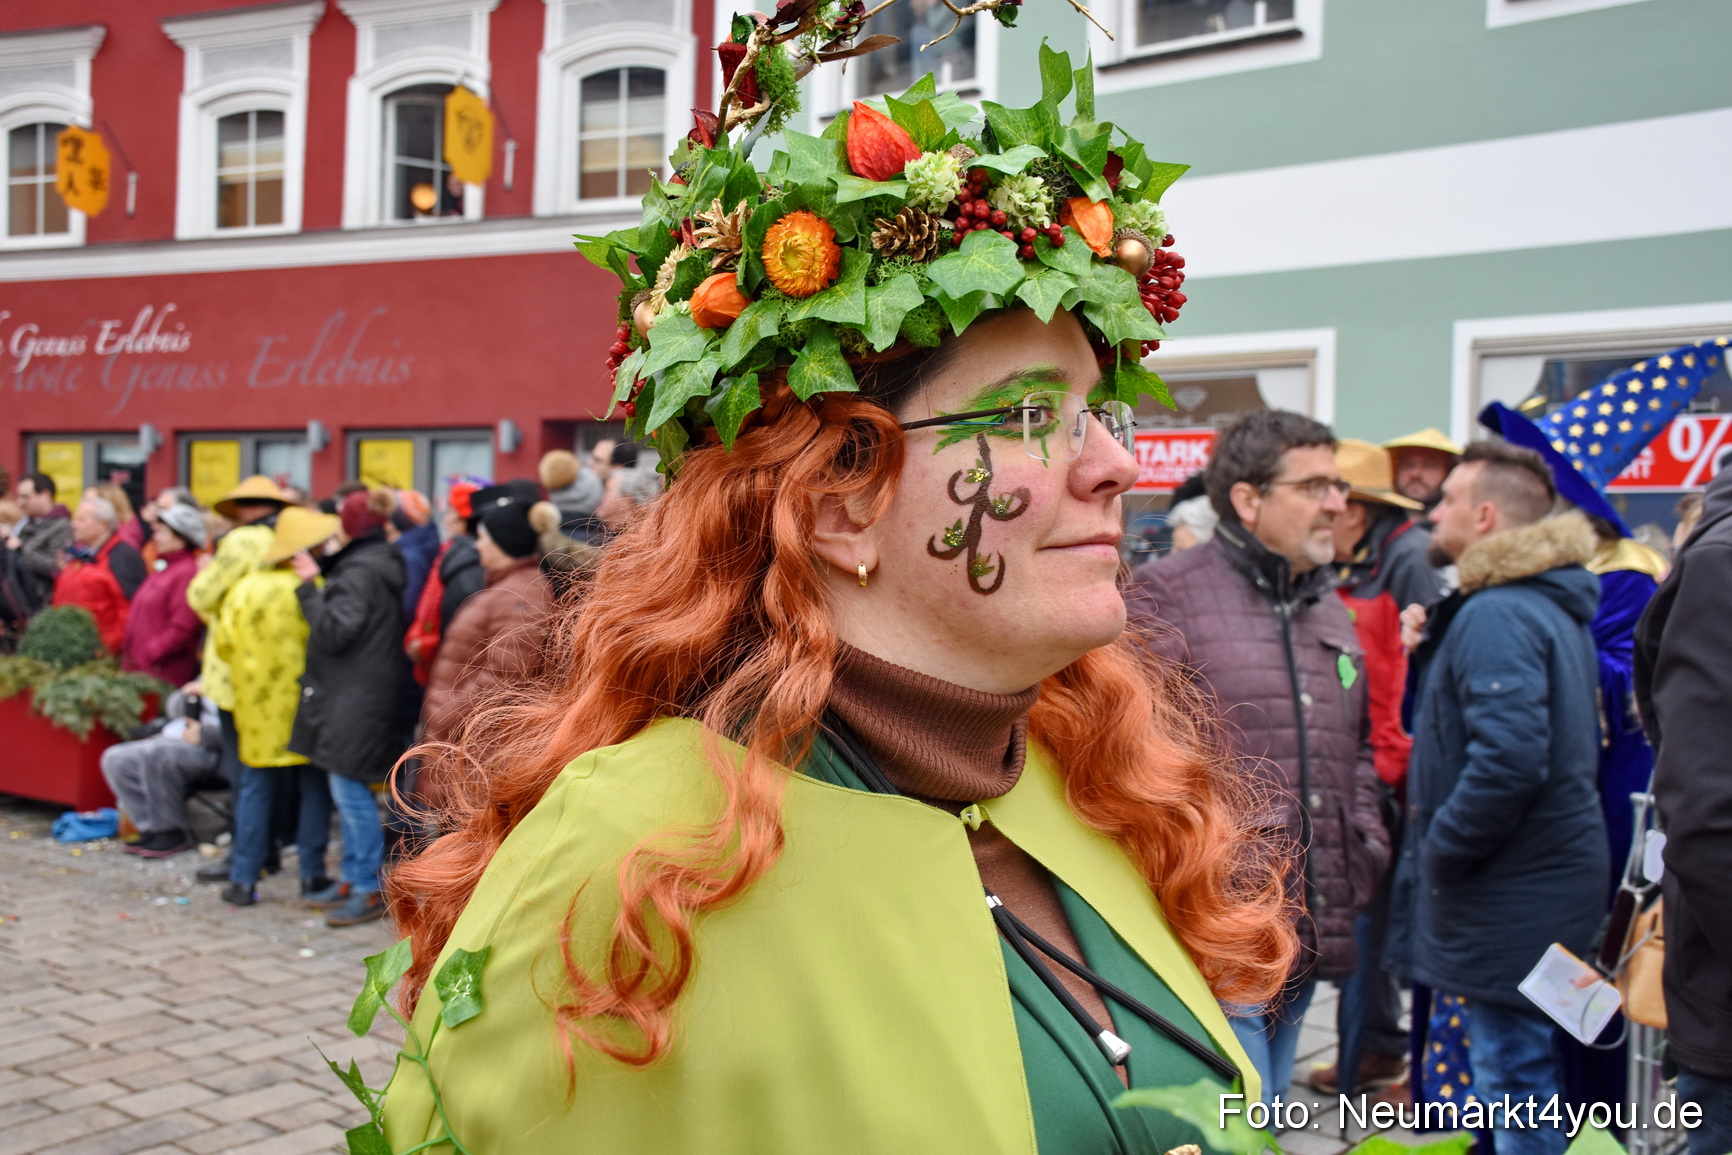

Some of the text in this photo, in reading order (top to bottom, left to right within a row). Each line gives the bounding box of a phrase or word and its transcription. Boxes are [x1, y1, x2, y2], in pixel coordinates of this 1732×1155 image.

[9, 323, 88, 373] Genuss
[95, 302, 191, 355] Erlebnis
[247, 306, 412, 389] Erlebnis
[1134, 439, 1210, 463] TARK
